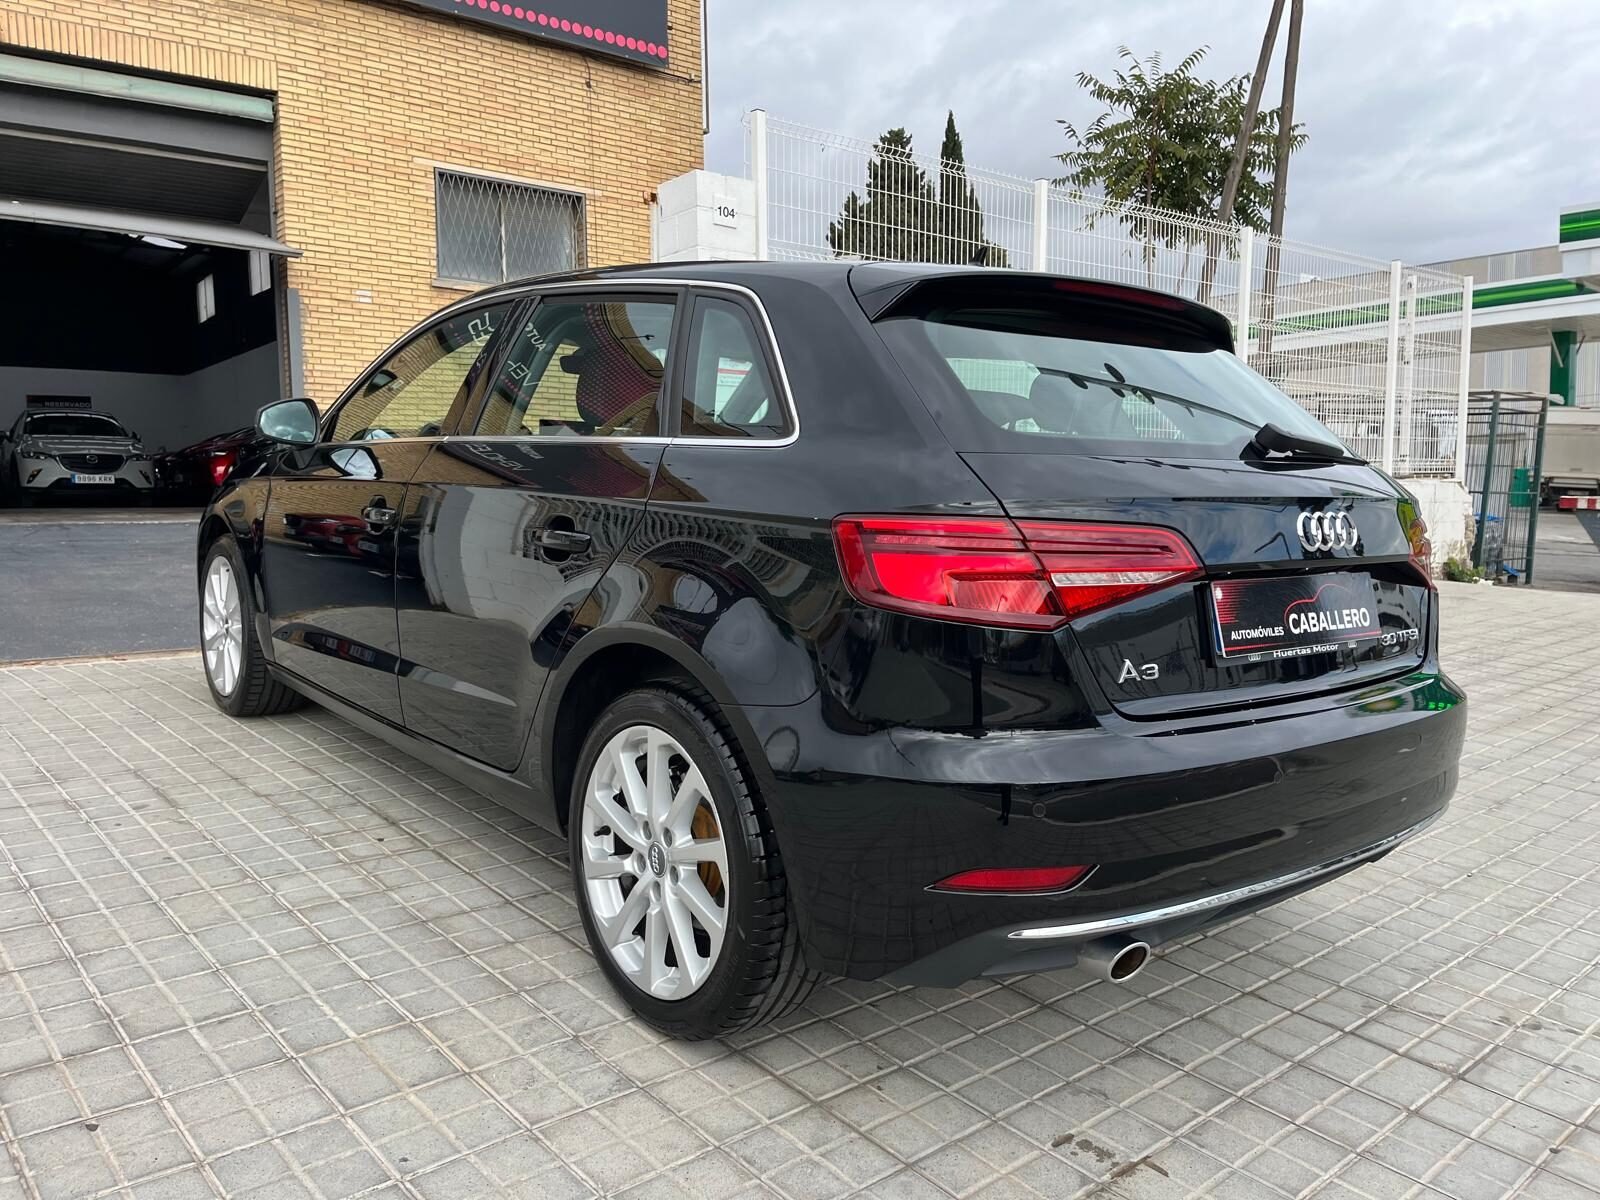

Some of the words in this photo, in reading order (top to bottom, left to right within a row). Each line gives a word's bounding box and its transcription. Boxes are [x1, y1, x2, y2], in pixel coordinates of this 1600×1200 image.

[717, 206, 736, 219] 104
[44, 400, 91, 408] RESERVADO
[1231, 625, 1285, 640] AUTOMÓVILES
[1288, 607, 1370, 634] CABALLERO
[1381, 632, 1397, 646] 30
[1273, 646, 1311, 658] Huertas
[1313, 642, 1339, 653] Motor
[1117, 658, 1159, 684] A3
